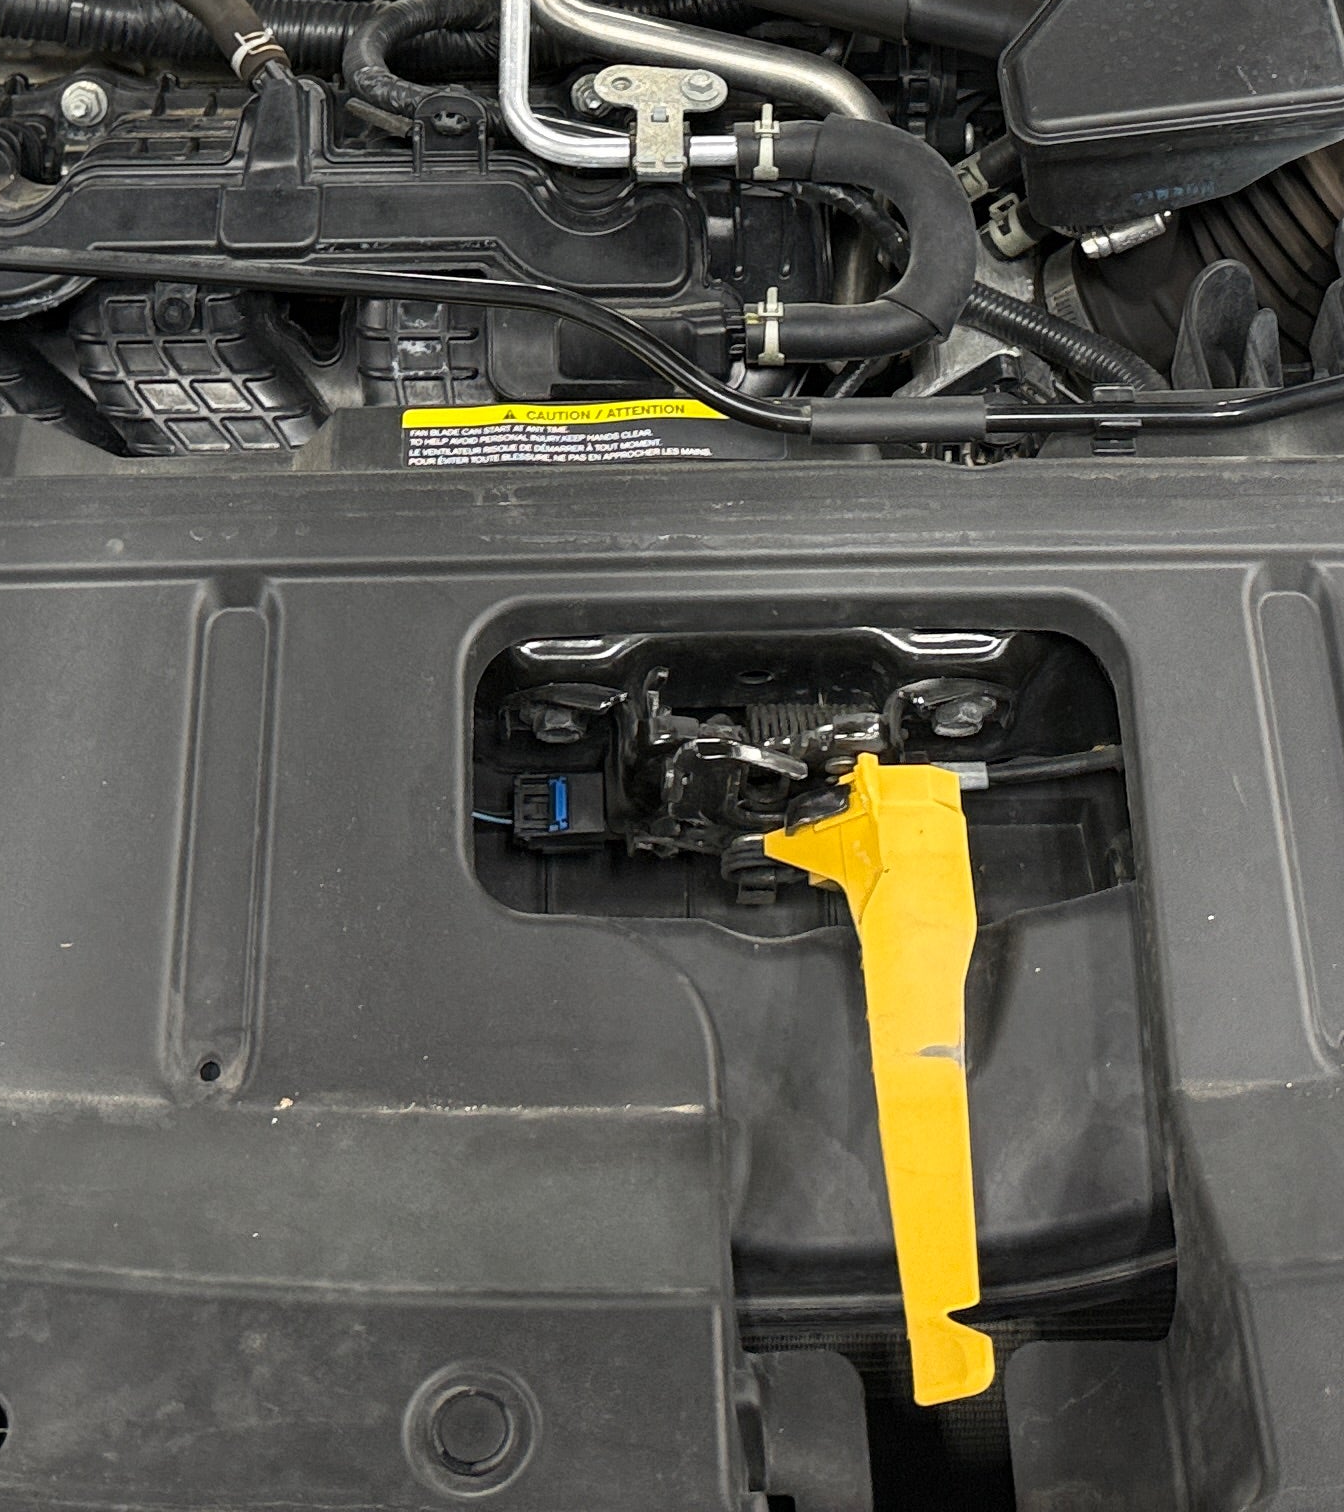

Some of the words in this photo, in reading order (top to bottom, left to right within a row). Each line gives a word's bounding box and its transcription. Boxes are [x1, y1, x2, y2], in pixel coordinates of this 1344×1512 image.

[526, 410, 591, 421] CAUTION
[606, 404, 685, 418] ATTENTION
[424, 438, 449, 446] HELP
[450, 437, 478, 445] AVOID
[479, 434, 529, 444] PERSONAL
[587, 432, 620, 441] HANDS
[621, 429, 653, 438] CLEAR.
[483, 426, 511, 434] START
[408, 457, 436, 465] POUR
[471, 454, 500, 463] TOUTE
[554, 454, 567, 462] NE
[568, 453, 587, 461] PAS
[588, 453, 602, 461] EN
[603, 448, 661, 460] APPROCHER
[661, 447, 680, 456] LES
[422, 447, 482, 456] VENTILATEUR
[483, 444, 518, 453] RISQUE
[519, 444, 533, 452] DE
[595, 442, 618, 451] TOUT
